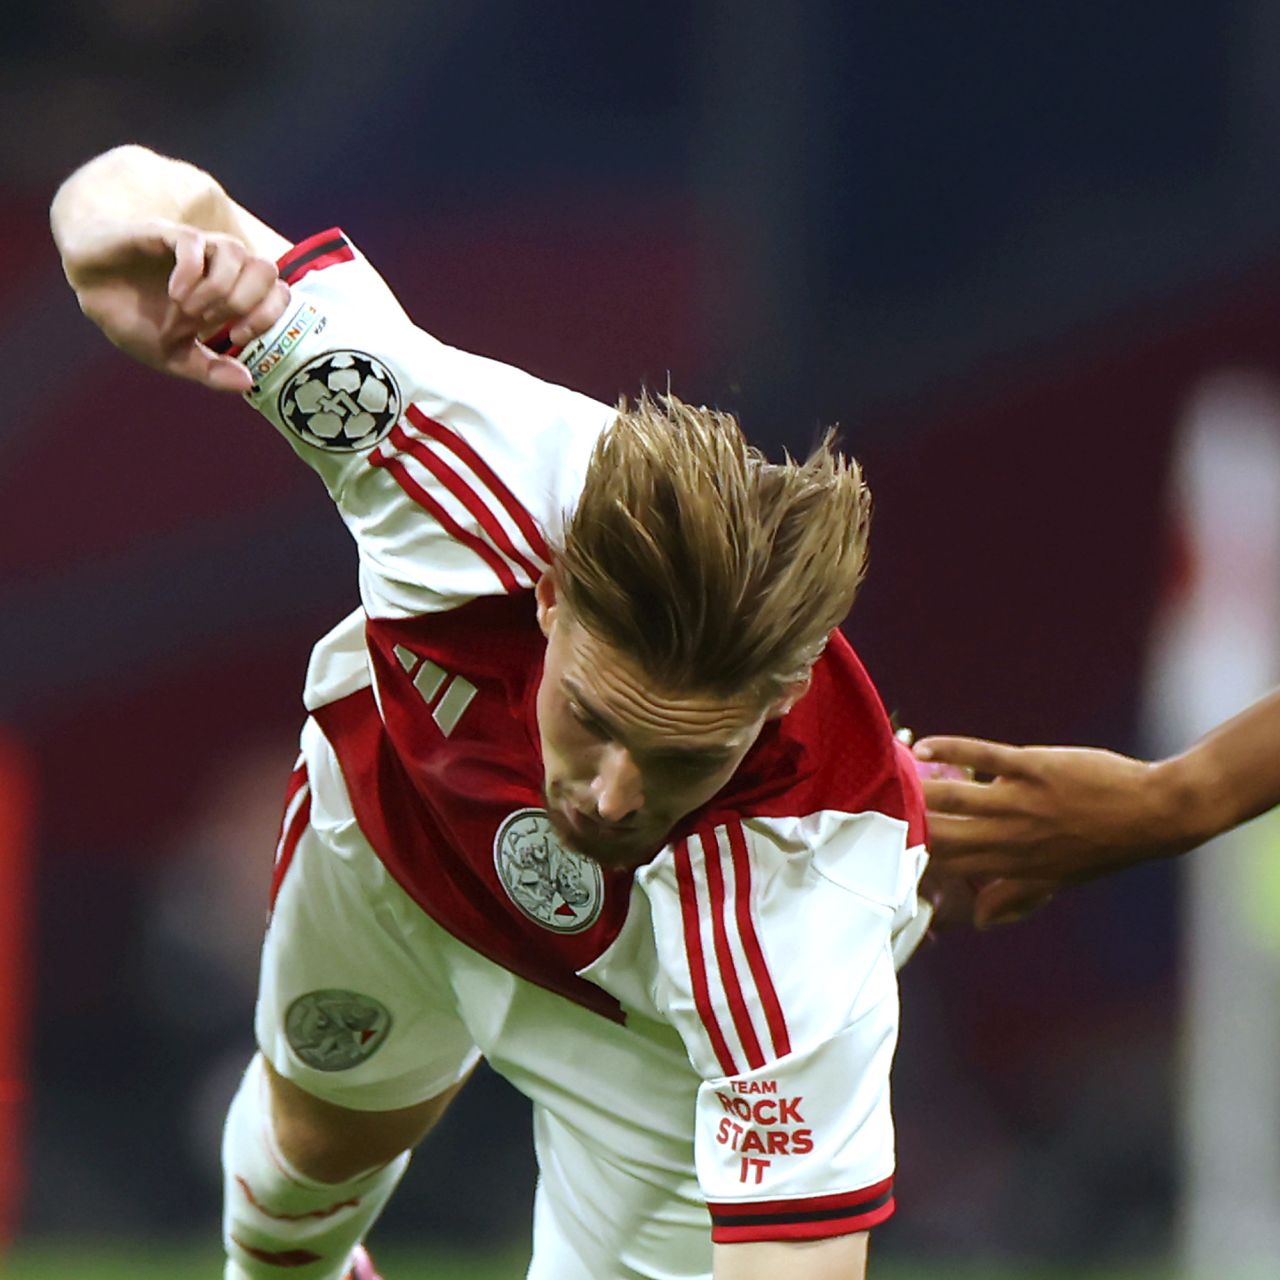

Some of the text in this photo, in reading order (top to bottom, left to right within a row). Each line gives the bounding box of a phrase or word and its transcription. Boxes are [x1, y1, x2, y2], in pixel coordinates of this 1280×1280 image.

[730, 1080, 777, 1094] TEAM
[715, 1091, 805, 1126] ROCK
[716, 1117, 814, 1155] STARS
[739, 1157, 771, 1185] IT
